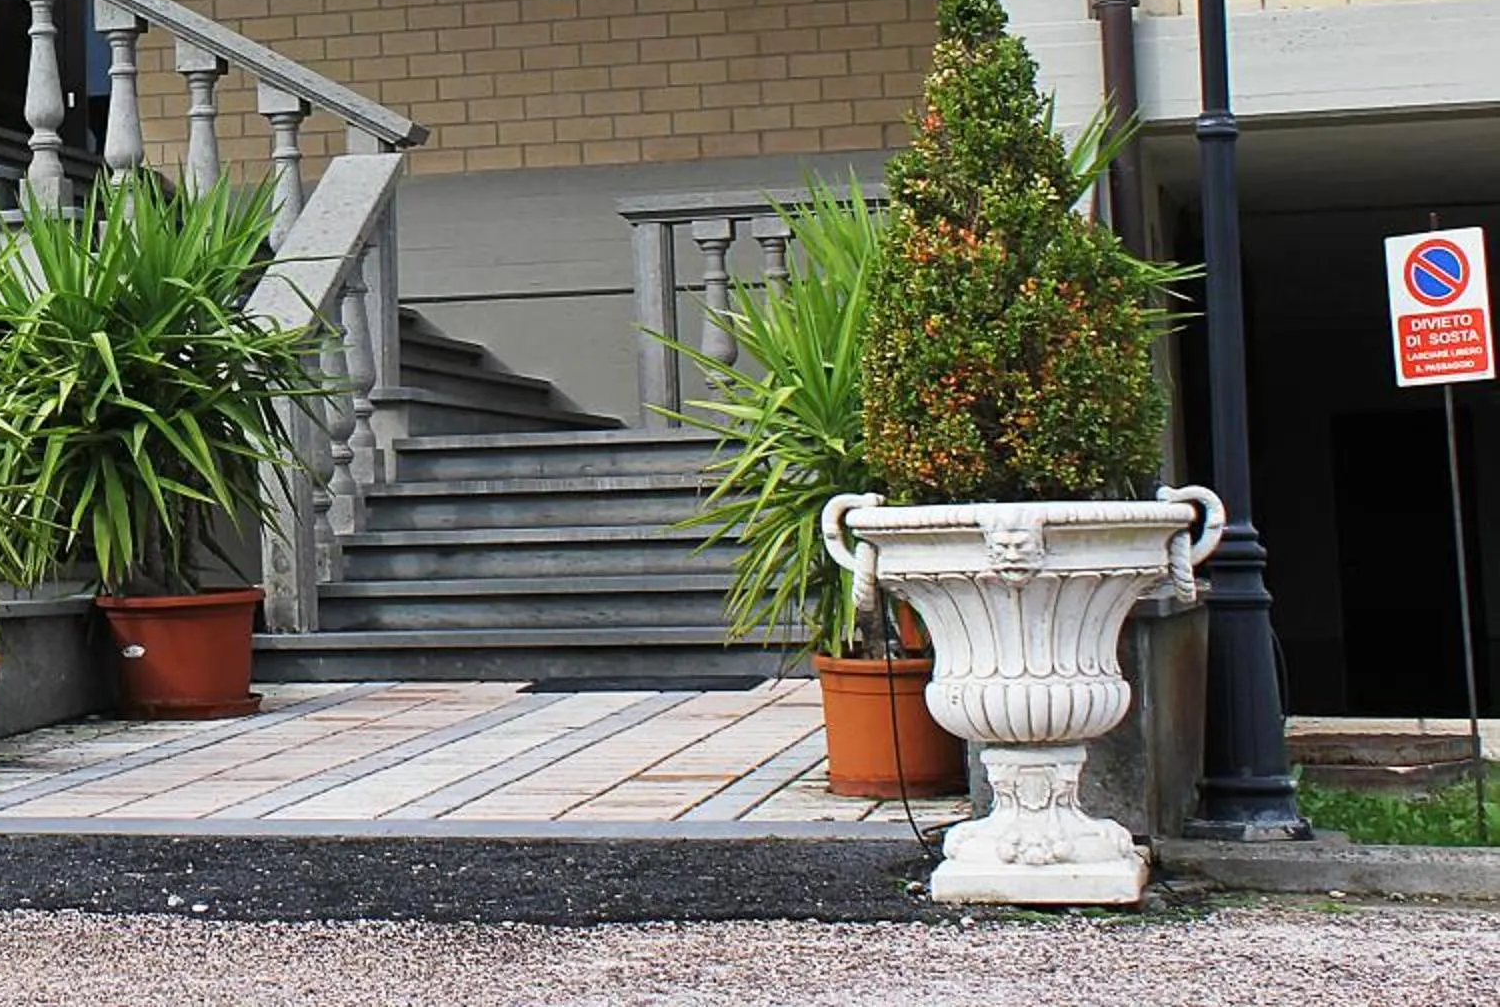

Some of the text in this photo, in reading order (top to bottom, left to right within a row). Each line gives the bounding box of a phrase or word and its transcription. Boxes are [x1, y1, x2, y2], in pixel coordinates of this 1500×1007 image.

[1411, 314, 1473, 331] DIVIETO
[1405, 329, 1480, 348] DI SOSTA
